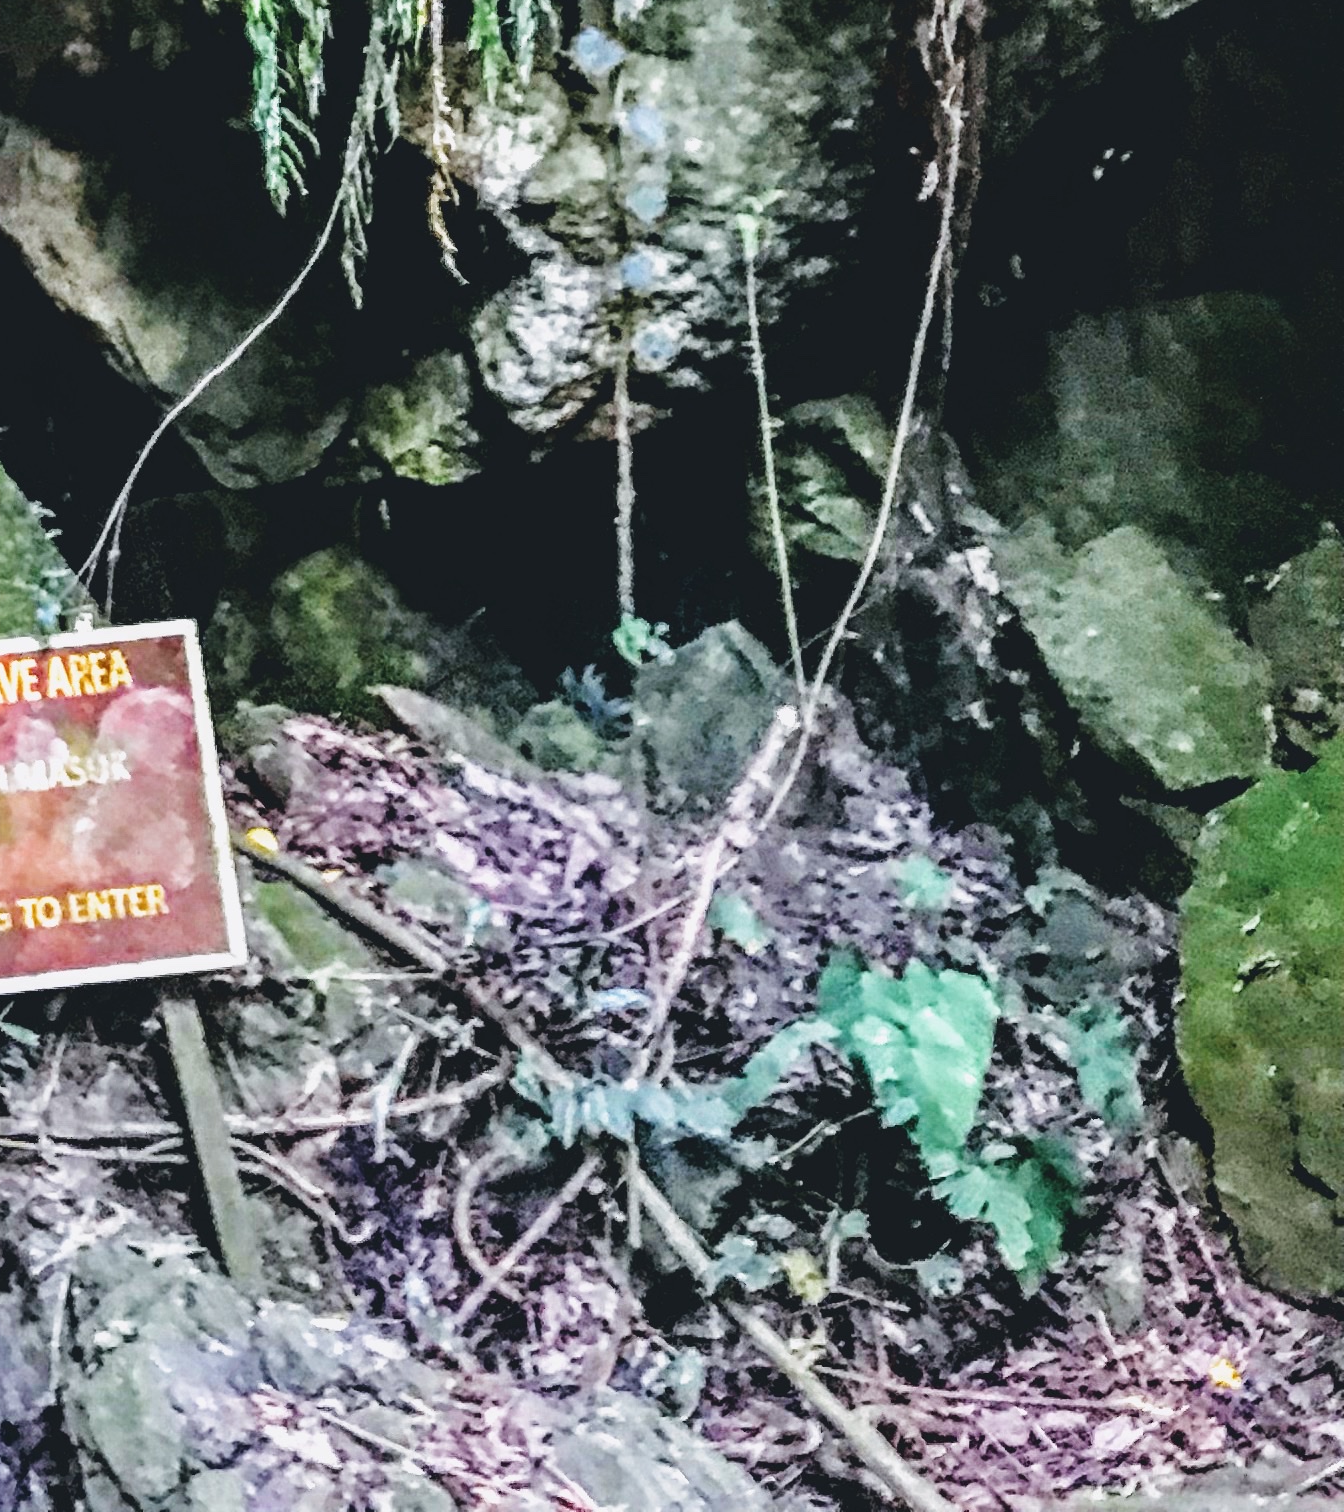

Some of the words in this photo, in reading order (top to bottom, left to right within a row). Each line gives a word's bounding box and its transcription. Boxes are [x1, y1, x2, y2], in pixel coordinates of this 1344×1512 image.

[46, 649, 134, 700] AREA
[14, 749, 132, 792] MASUK
[17, 896, 62, 930] TO
[68, 885, 170, 924] ENTER
